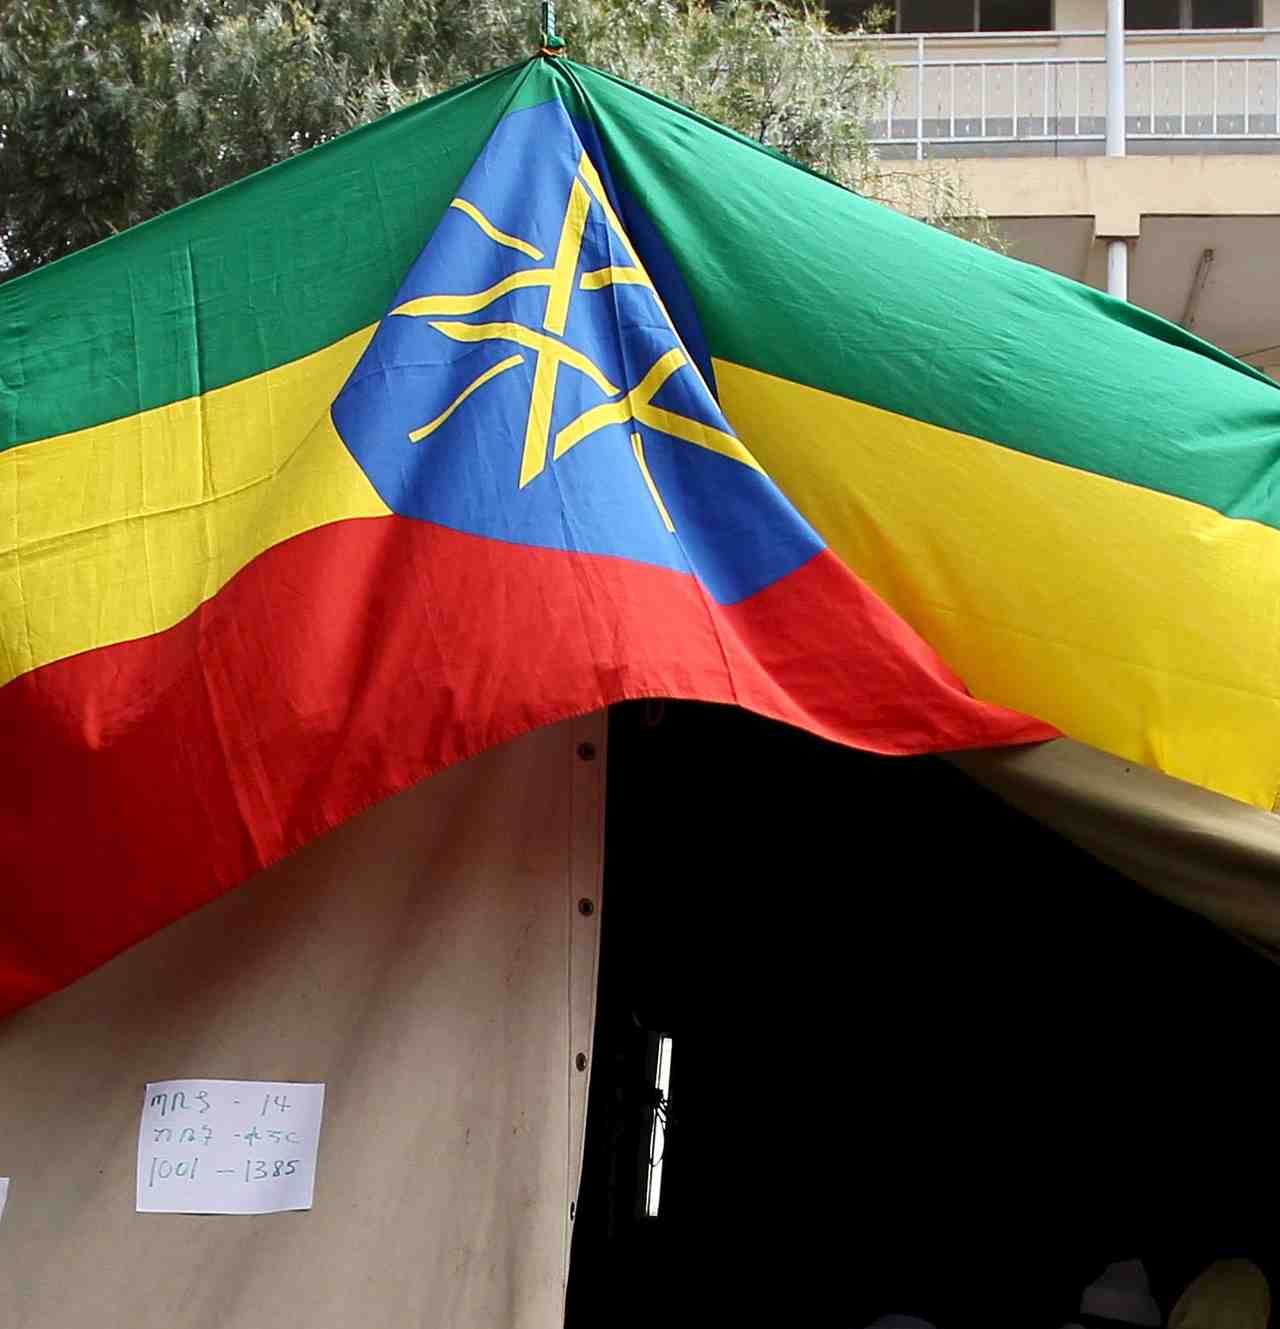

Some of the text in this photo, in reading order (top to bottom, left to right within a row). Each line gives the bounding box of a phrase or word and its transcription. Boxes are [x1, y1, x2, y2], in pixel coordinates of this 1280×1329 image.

[261, 1094, 292, 1116] 14
[149, 1157, 198, 1187] 1001
[246, 1159, 301, 1183] 1385
